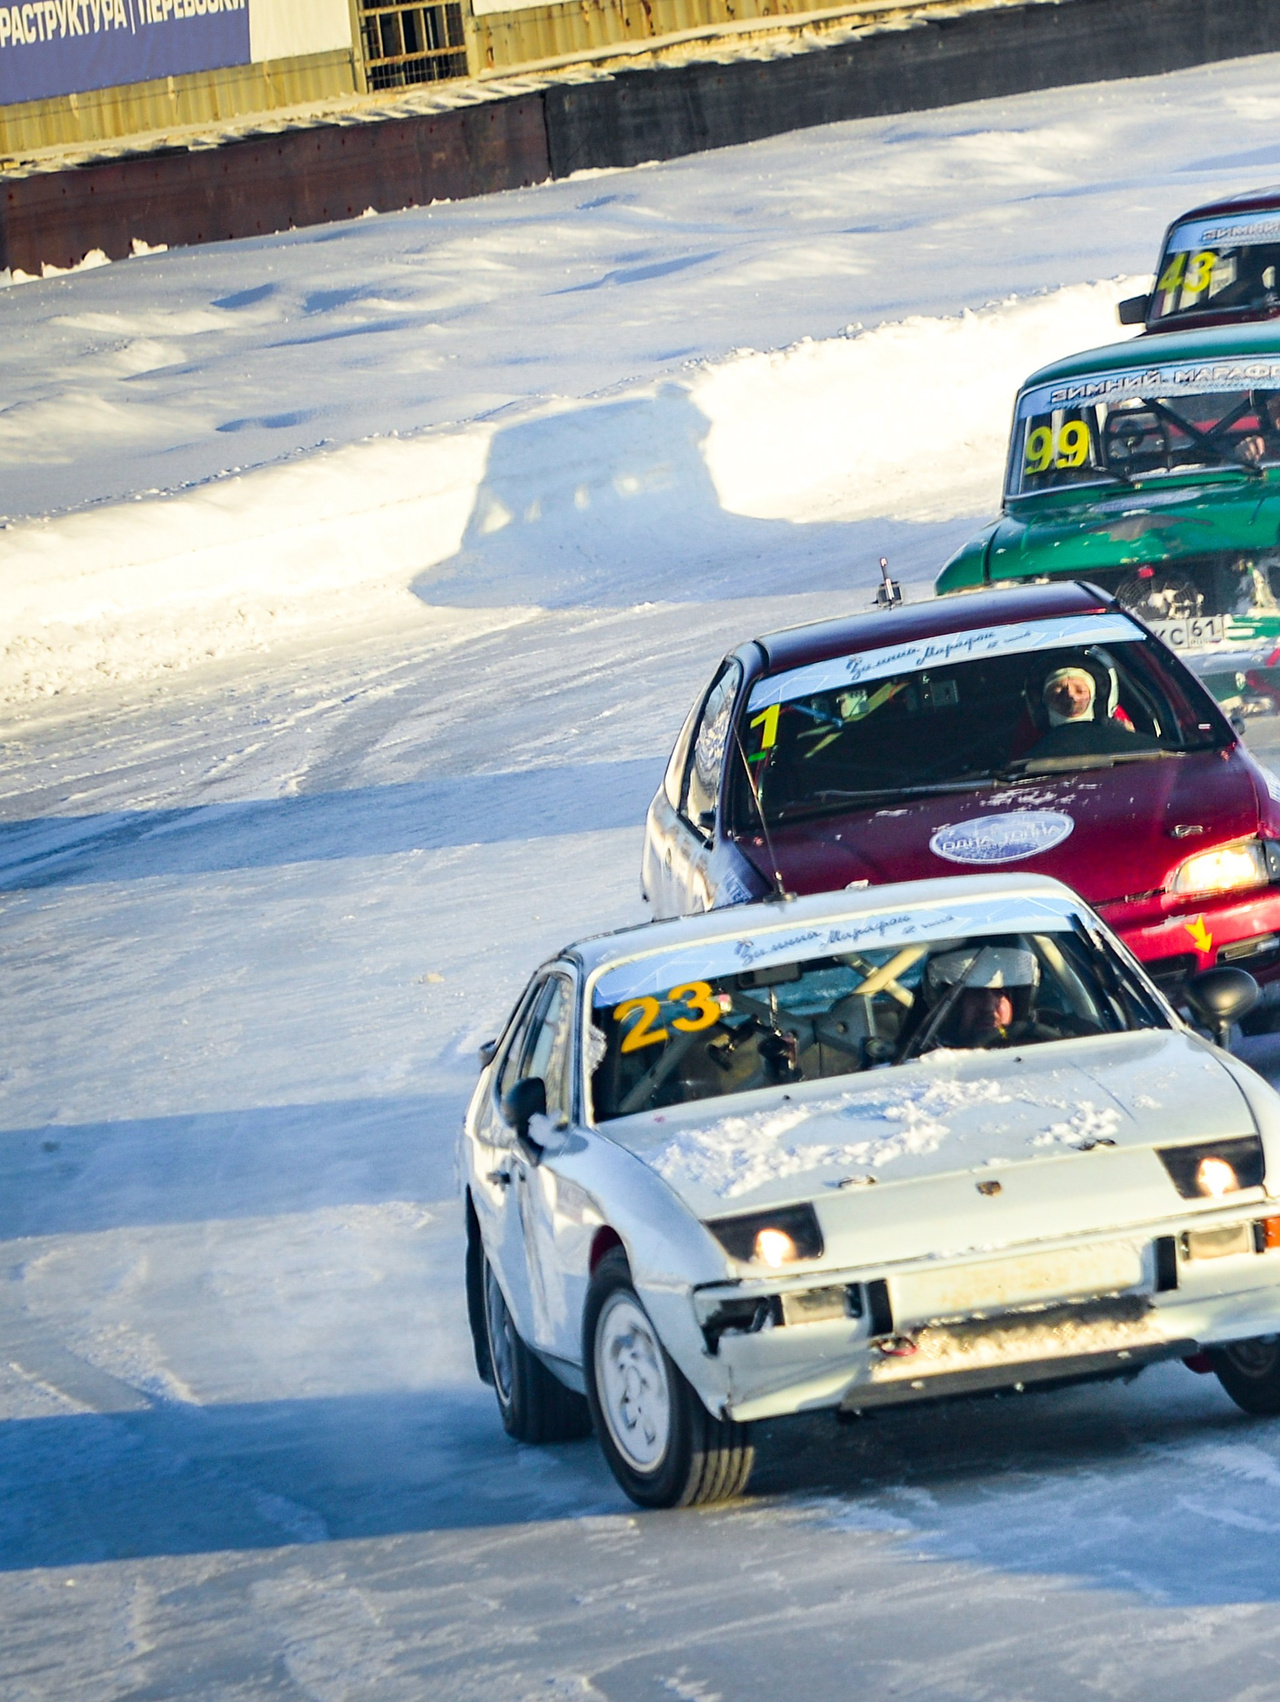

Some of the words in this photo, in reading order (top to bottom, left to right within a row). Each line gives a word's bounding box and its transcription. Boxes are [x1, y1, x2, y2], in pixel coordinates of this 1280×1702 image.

[1157, 250, 1216, 294] 43
[1050, 369, 1159, 403] ЗИМНИЙ
[1024, 419, 1090, 475] 99
[1191, 619, 1216, 637] 61
[749, 703, 781, 749] 1
[613, 981, 722, 1054] 23
